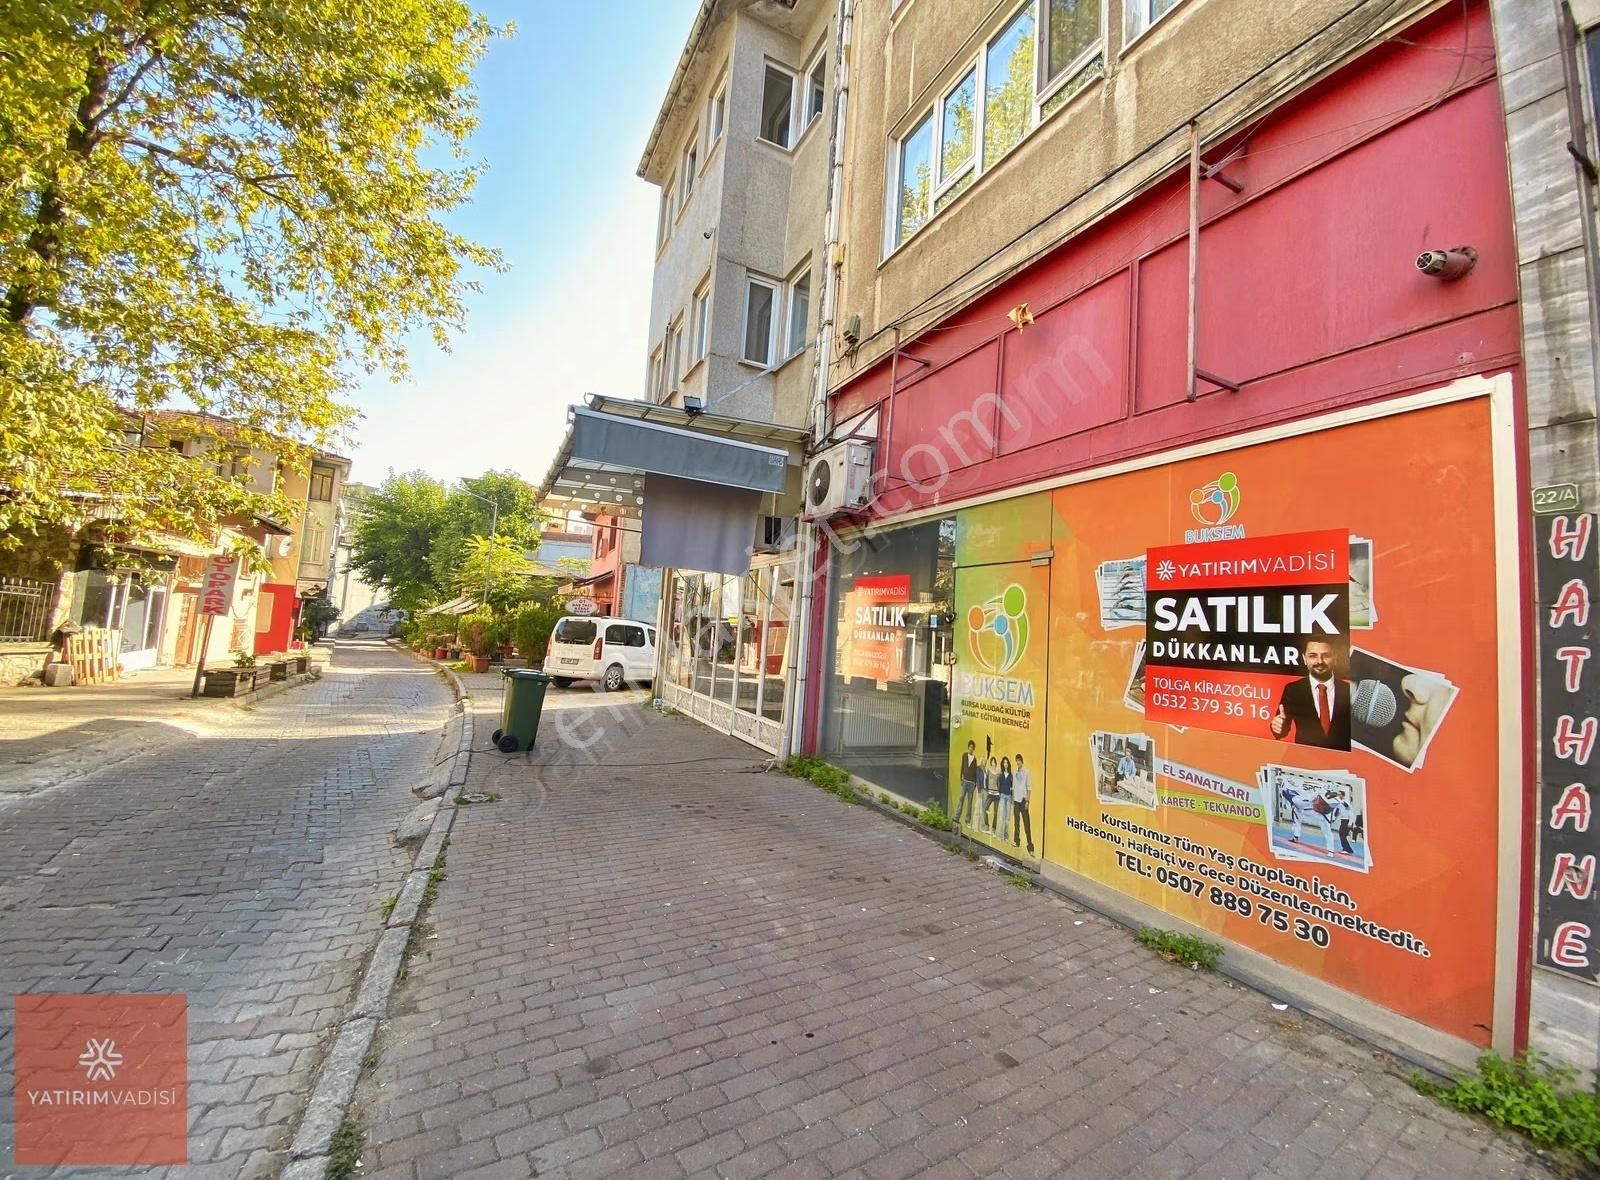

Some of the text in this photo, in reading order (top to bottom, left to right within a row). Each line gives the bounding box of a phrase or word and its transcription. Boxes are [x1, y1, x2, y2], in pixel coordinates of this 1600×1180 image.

[1536, 488, 1575, 505] 22/A
[1184, 524, 1246, 544] BUKSEM
[1178, 550, 1336, 577] YATIRIMVADİSİ
[203, 556, 235, 615] OTOPARK
[855, 606, 906, 628] SATILIK
[1154, 594, 1340, 634] SATILIK
[853, 630, 896, 642] DÜKKANLAR
[1153, 638, 1299, 665] DÜKKANLAR
[958, 674, 1034, 706] BUKSEM
[1153, 677, 1271, 700] TOLGA KİRAZOĞLU
[961, 699, 1031, 719] BURSA ULUDAĞ KÜLTÜR
[1153, 692, 1270, 720] 0532 379 36 16
[980, 712, 1001, 723] EĞİTİM
[1002, 717, 1030, 729] DERNEĞİ
[1549, 513, 1597, 967] HATHANE
[1163, 764, 1250, 802] EL SANATLARI
[1160, 795, 1196, 809] KARETE
[1203, 801, 1261, 818] TEKVANDO
[1101, 813, 1356, 909] Kurslarımız Tüm Yaş Grupları İçin,
[1066, 817, 1430, 956] Haftasonu, Haftaiçi ve Gece Düzenlenmektedir.
[1115, 850, 1329, 947] TEL: 0507 889 75 30
